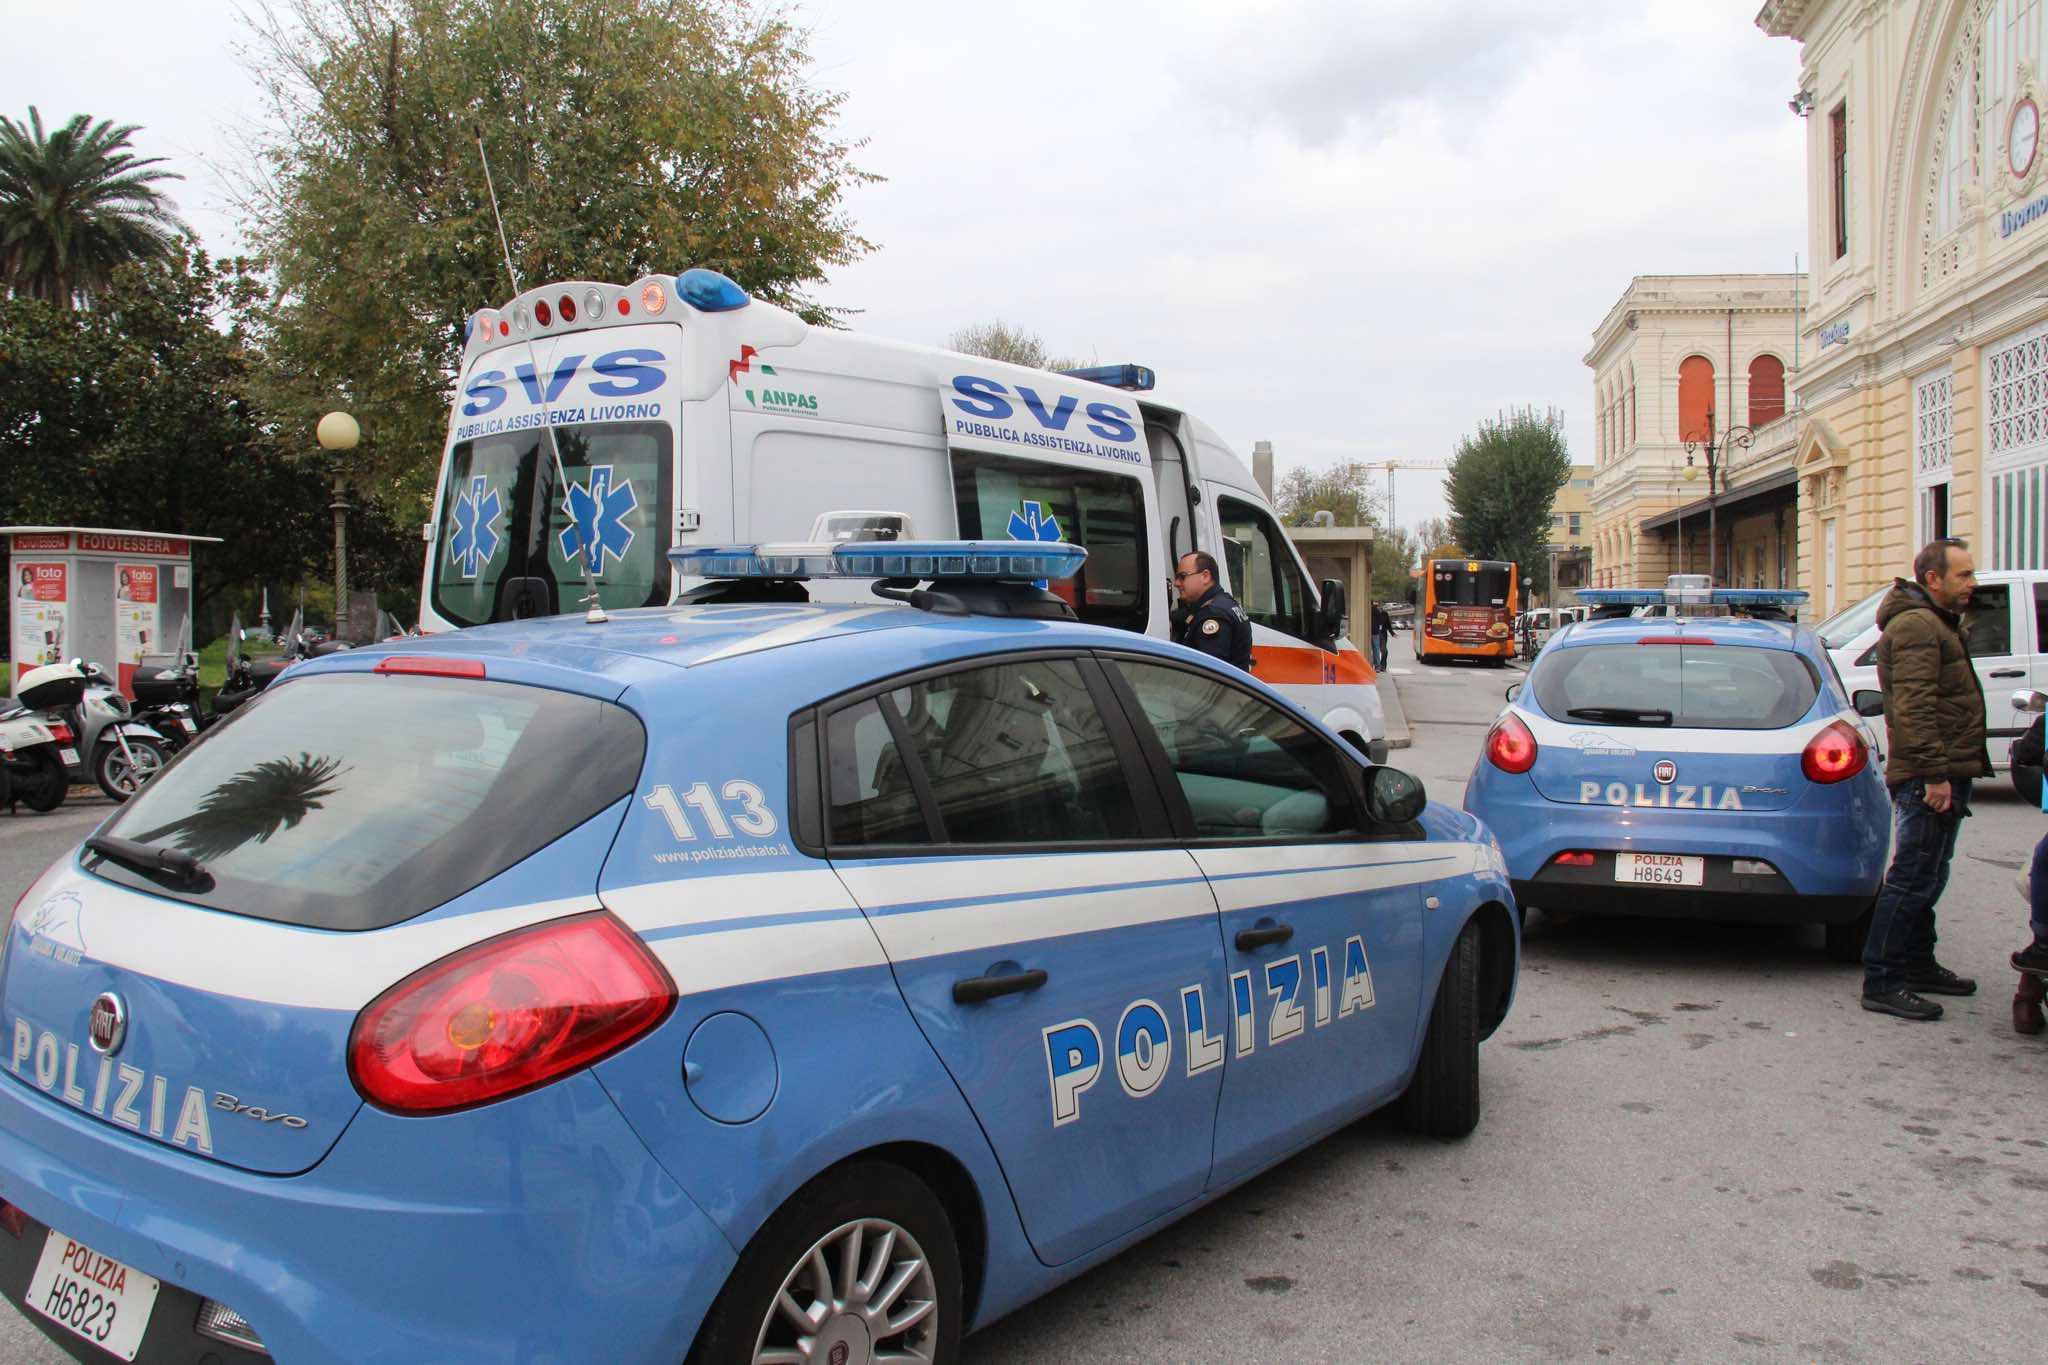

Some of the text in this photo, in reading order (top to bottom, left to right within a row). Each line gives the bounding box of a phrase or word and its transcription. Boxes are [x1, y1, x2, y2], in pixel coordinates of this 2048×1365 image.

[461, 348, 667, 417] SVS
[762, 389, 818, 410] ANPAS
[457, 403, 661, 440] PUBBLICA ASSISTENZA LIVORNO
[951, 375, 1137, 443] SVS
[956, 420, 1141, 463] PUBBLICA ASSISTENZA LIVORNO
[82, 535, 170, 553] FOTOTESSERA
[36, 567, 63, 579] foto
[131, 570, 153, 580] foto
[1658, 766, 1673, 778] FIAT
[642, 779, 778, 841] 113
[1579, 781, 1744, 810] POLIZIA
[653, 843, 790, 864] www.poliziadistato.it
[1634, 855, 1683, 866] POLIZIA
[1634, 867, 1683, 883] H8649
[95, 1008, 115, 1040] FIAT
[1041, 935, 1376, 1129] POLIZIA
[11, 1017, 213, 1154] POLIZIA
[213, 1091, 308, 1129] Bravo
[62, 1241, 127, 1296] POLIZIA
[45, 1273, 117, 1341] H6823
